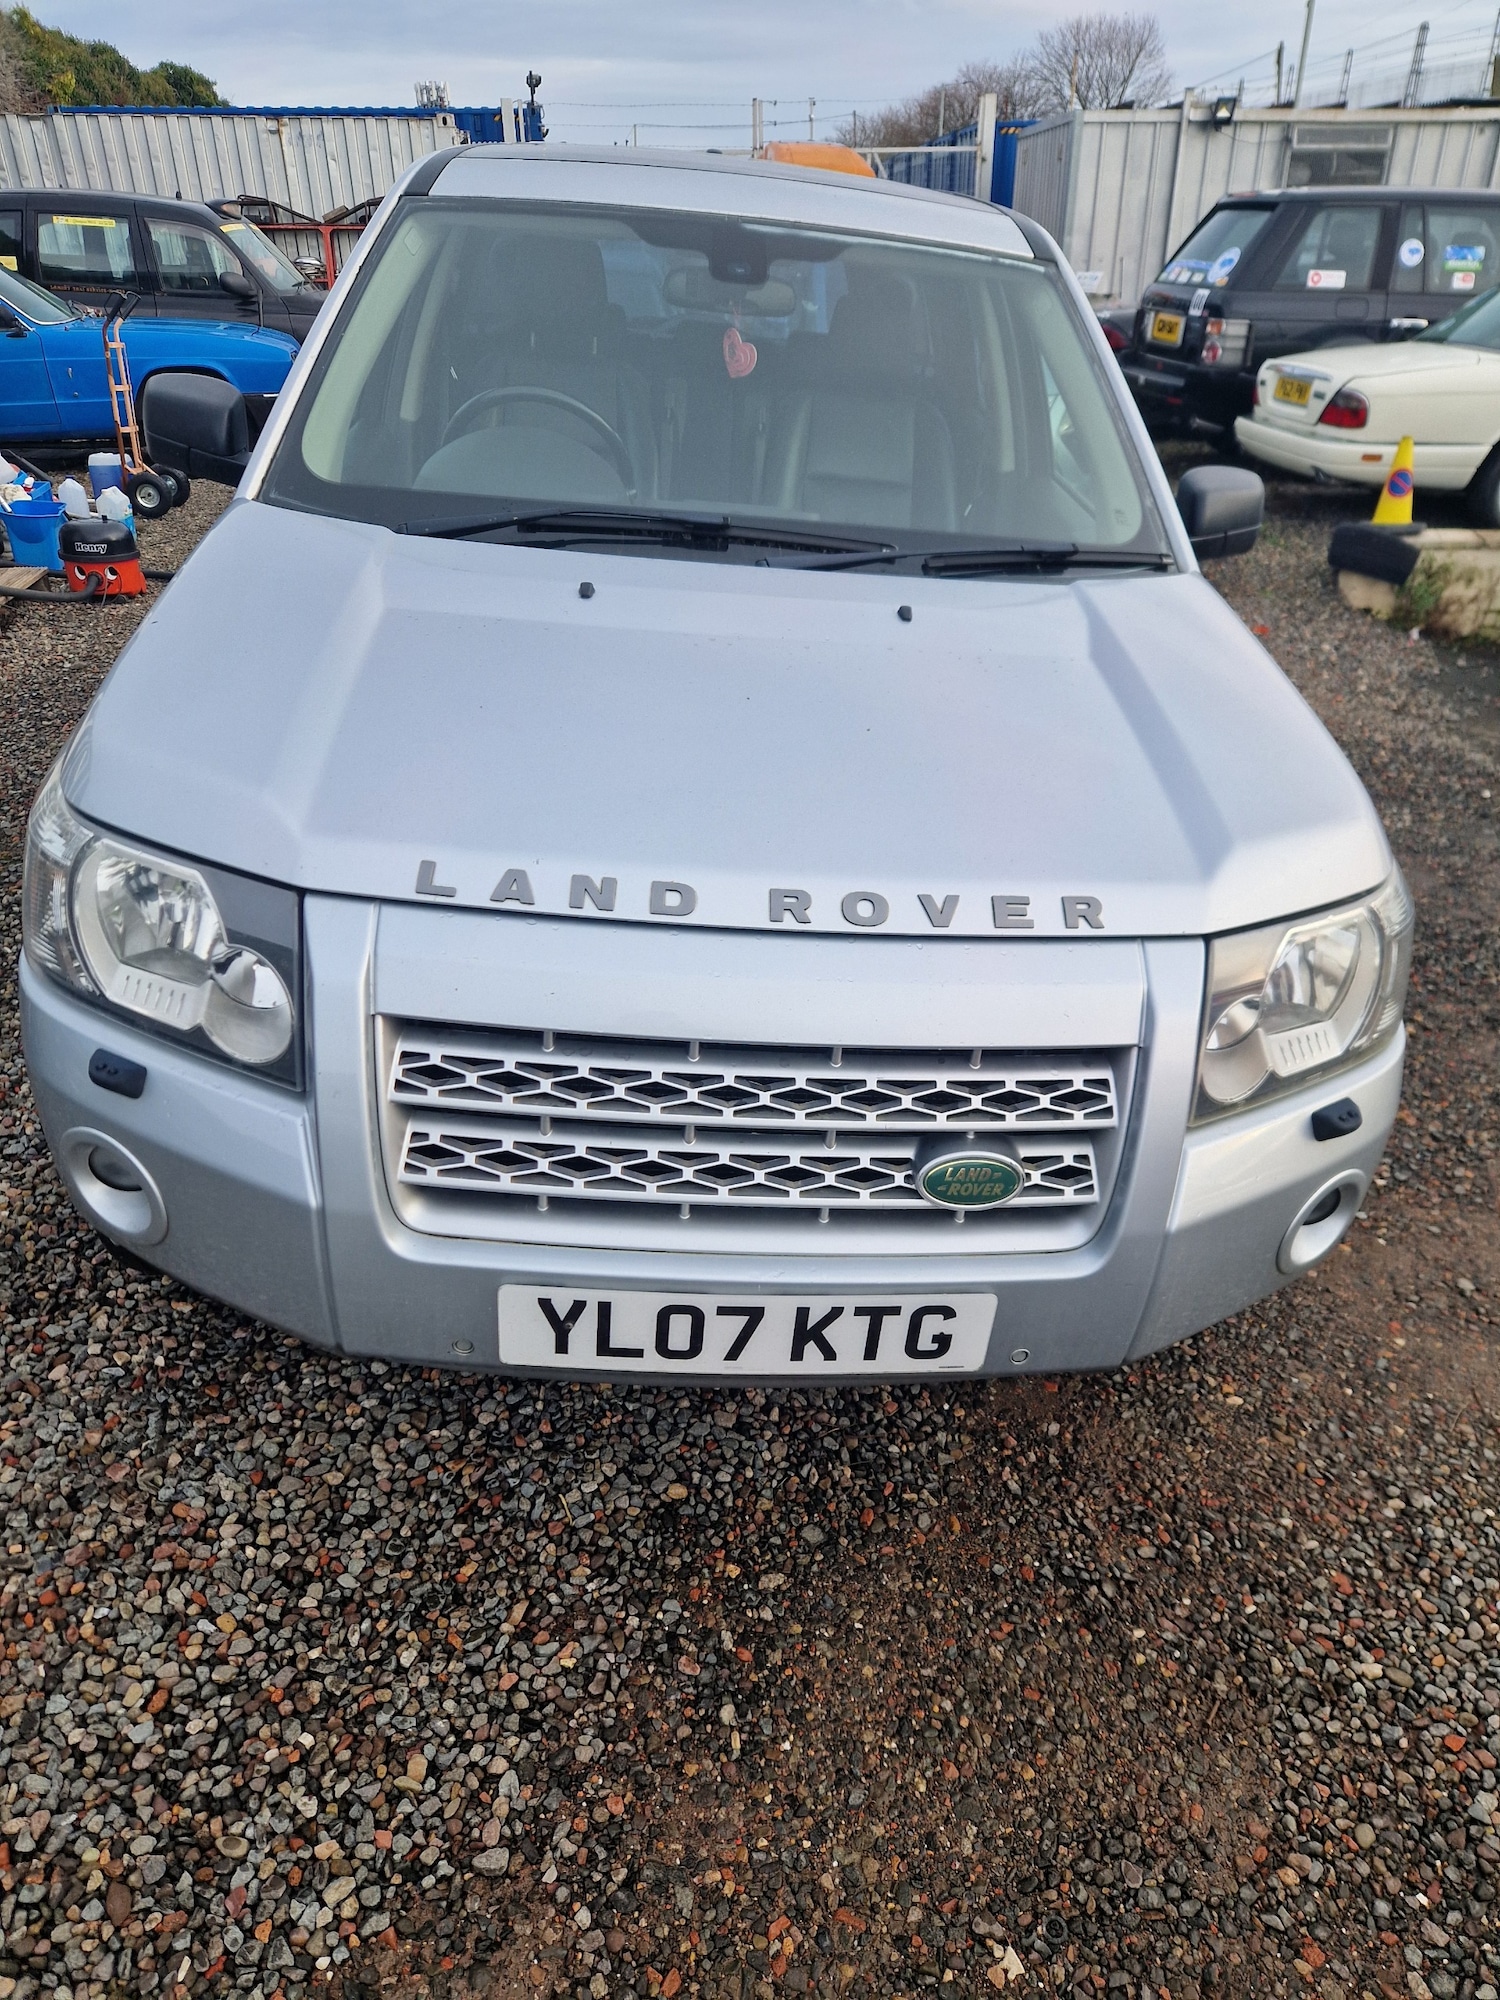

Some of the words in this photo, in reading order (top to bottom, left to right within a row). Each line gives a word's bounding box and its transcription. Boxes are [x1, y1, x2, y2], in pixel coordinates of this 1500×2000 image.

[74, 542, 107, 554] Henry
[415, 860, 698, 917] LAND
[769, 888, 1105, 929] ROVER
[944, 1167, 992, 1181] LAND
[946, 1183, 1004, 1196] ROVER
[537, 1297, 765, 1361] YL07
[790, 1305, 957, 1361] KTG
